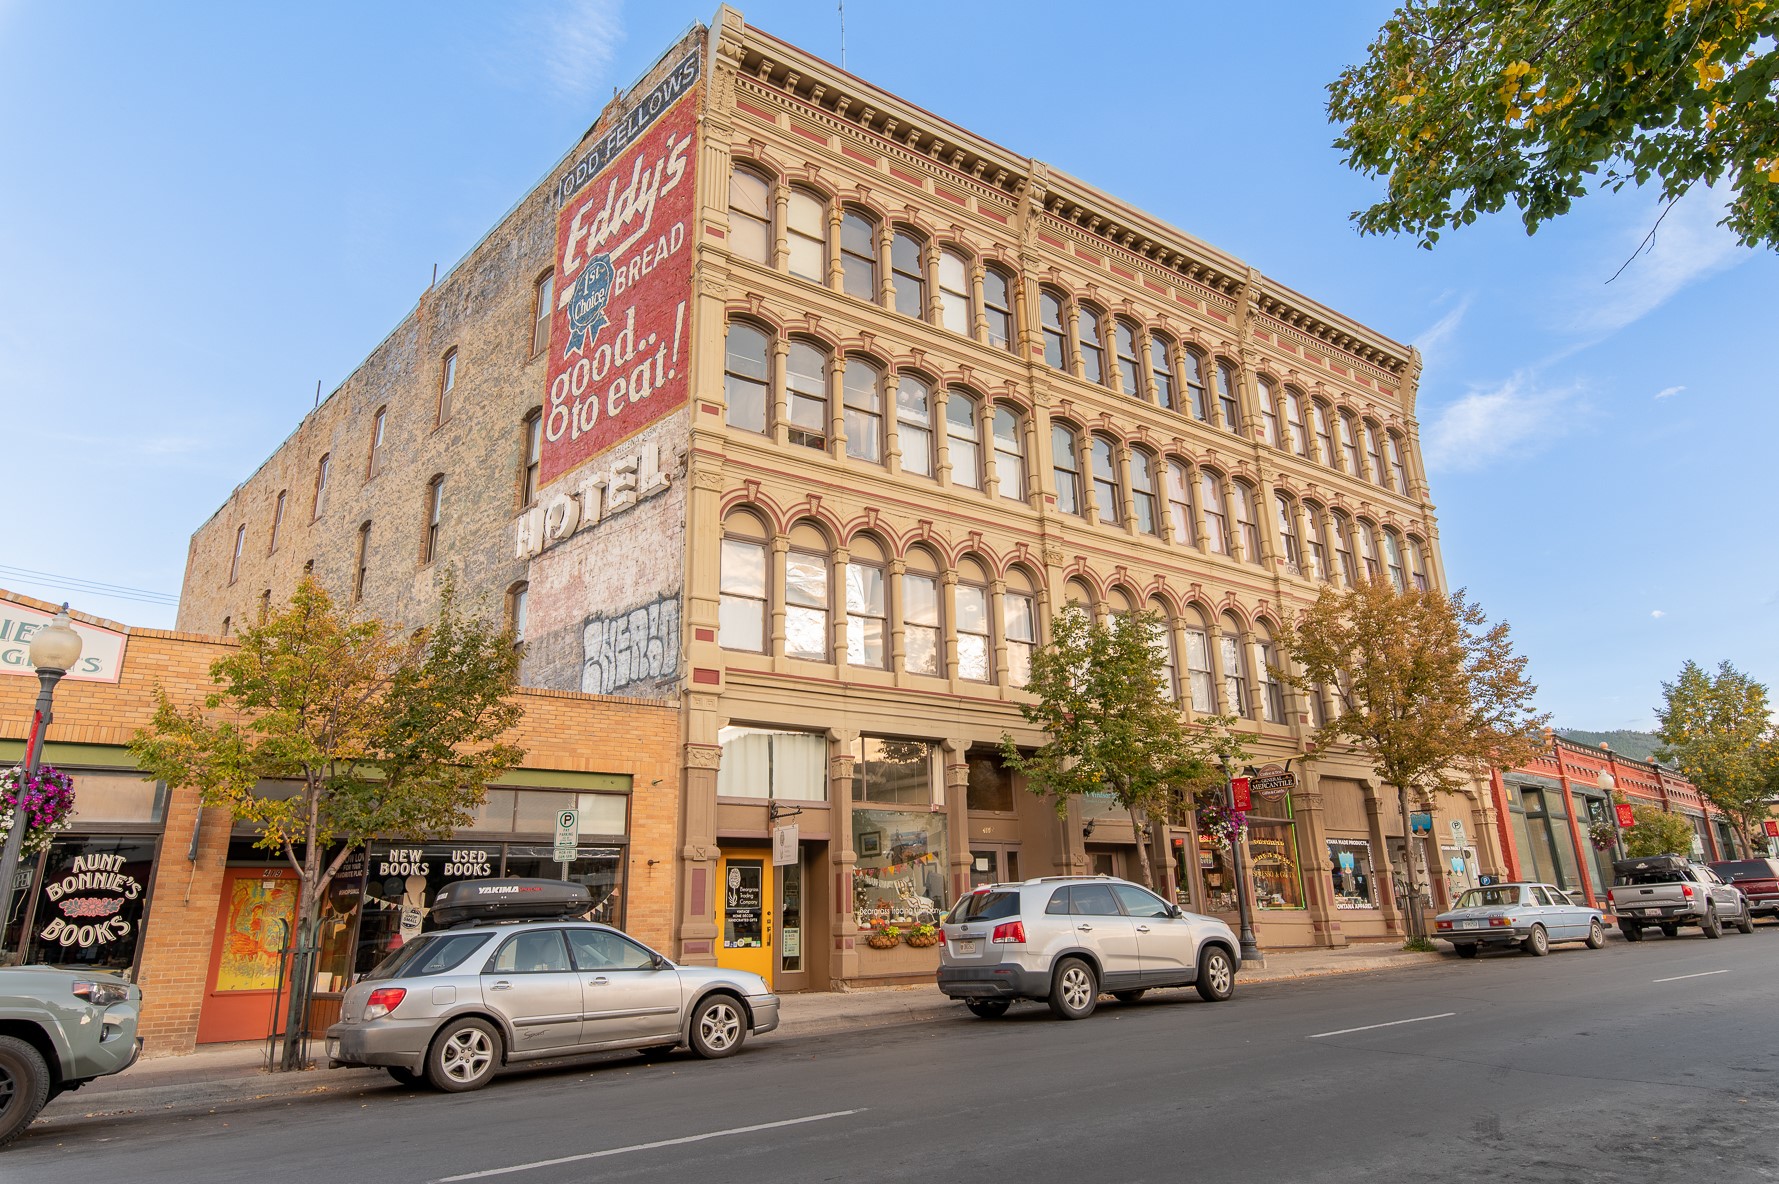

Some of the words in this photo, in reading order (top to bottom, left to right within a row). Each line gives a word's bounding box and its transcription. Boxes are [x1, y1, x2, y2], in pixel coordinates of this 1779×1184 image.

[563, 151, 599, 196] ODD
[606, 57, 696, 158] FELLOWS
[561, 131, 692, 279] Eddy's
[614, 221, 685, 297] BREAD
[582, 265, 601, 296] 1st
[574, 288, 606, 320] Choice
[571, 391, 599, 441] to
[607, 300, 686, 418] eat!
[515, 441, 672, 559] HOTEL
[1252, 780, 1293, 790] MERCANTILE
[564, 814, 572, 825] P
[72, 853, 127, 874] AUNT
[379, 862, 430, 876] BOOKS
[389, 849, 423, 862] NEW
[443, 863, 492, 876] BOOKS
[451, 850, 488, 863] USED
[45, 872, 142, 902] BONNIE'S
[478, 885, 519, 894] YAKIMA
[40, 915, 131, 948] BOOKS
